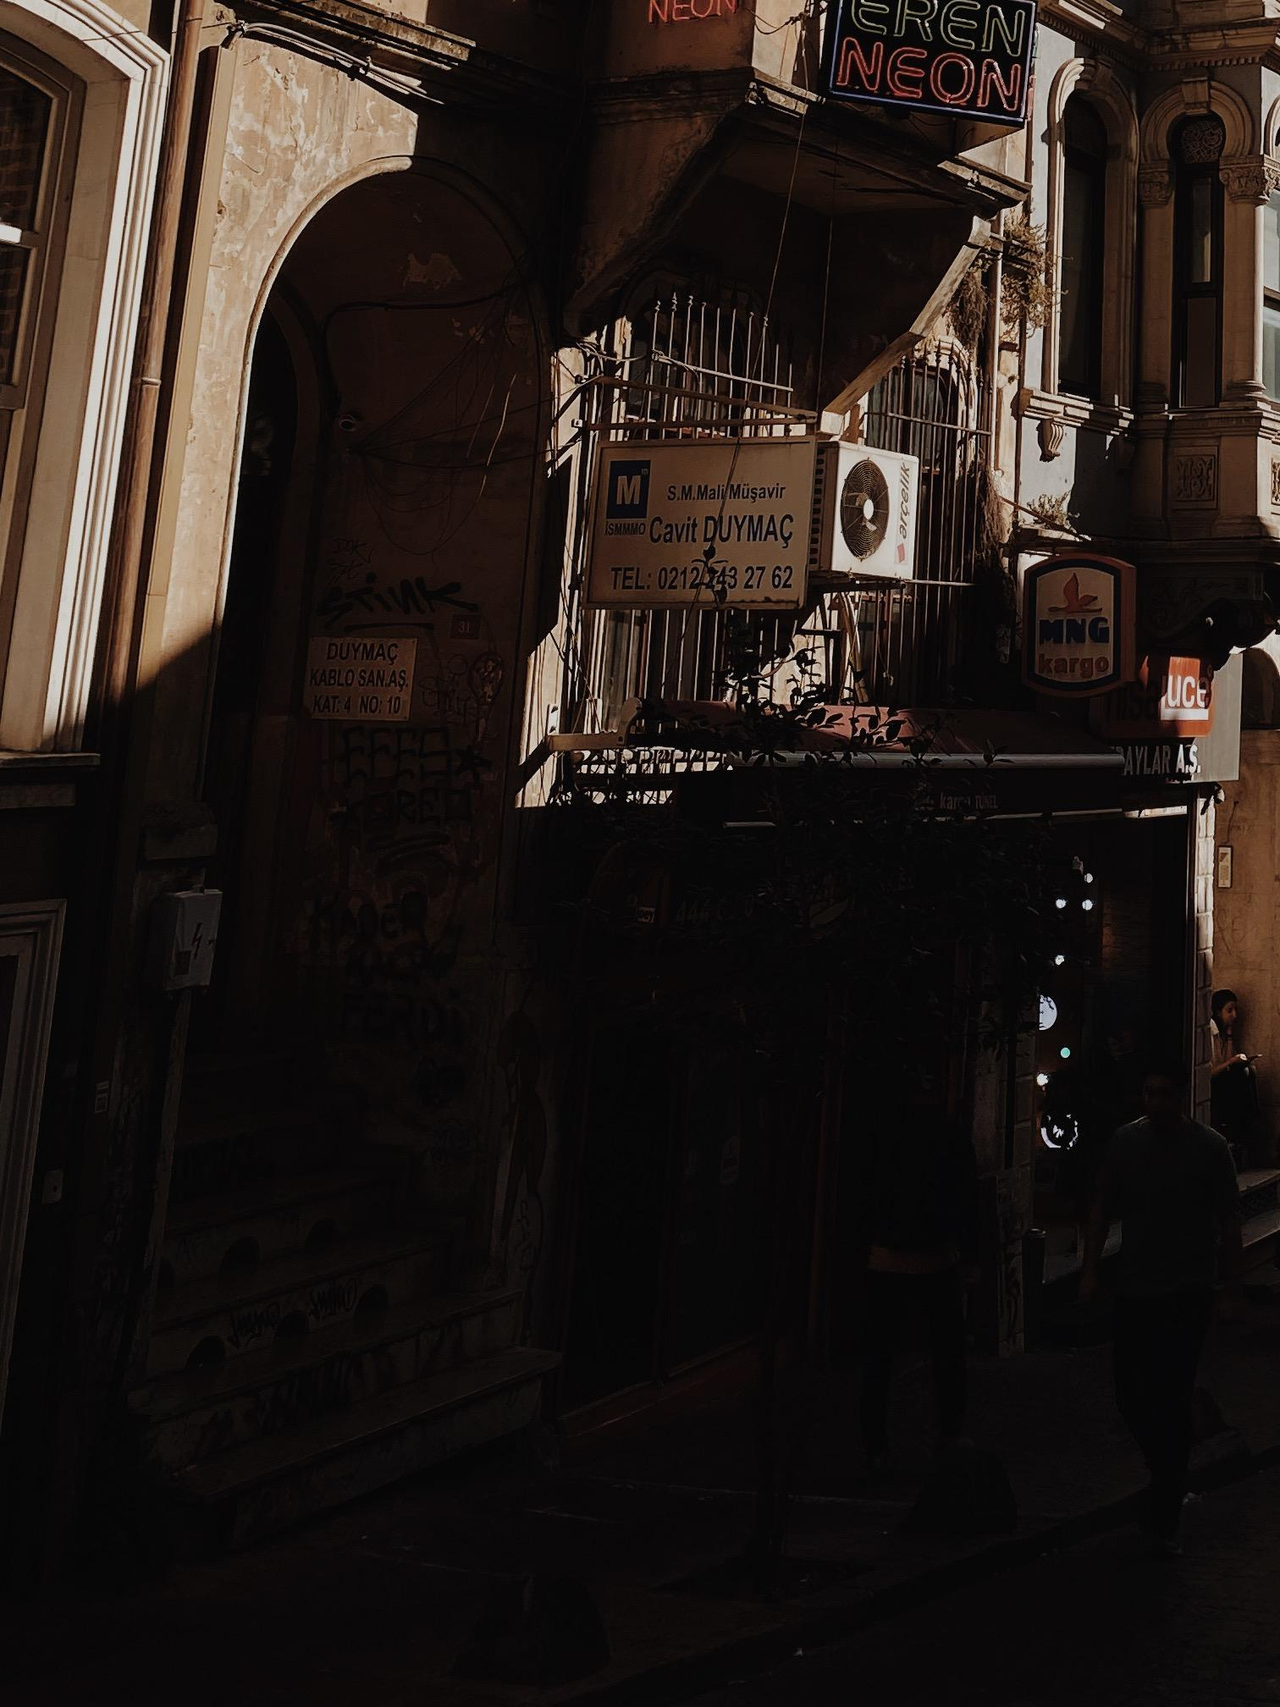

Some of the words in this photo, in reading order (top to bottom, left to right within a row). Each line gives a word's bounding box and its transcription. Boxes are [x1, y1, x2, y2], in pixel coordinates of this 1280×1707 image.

[836, 37, 1022, 112] NEON
[615, 474, 643, 505] M
[729, 482, 786, 503] Müşavir
[650, 515, 698, 544] Cavit
[703, 514, 794, 549] DUYMAÇ
[610, 566, 651, 590] TEL:
[658, 566, 700, 590] 0212
[744, 566, 766, 590] 27
[772, 565, 793, 589] 62
[1039, 617, 1110, 644] MNG
[327, 642, 399, 666] DUYMAÇ
[1038, 654, 1109, 678] kargo
[309, 669, 355, 687] KABLO
[312, 695, 340, 714] KAT:
[344, 695, 351, 713] 4
[359, 695, 383, 714] NO:
[387, 695, 401, 714] 10
